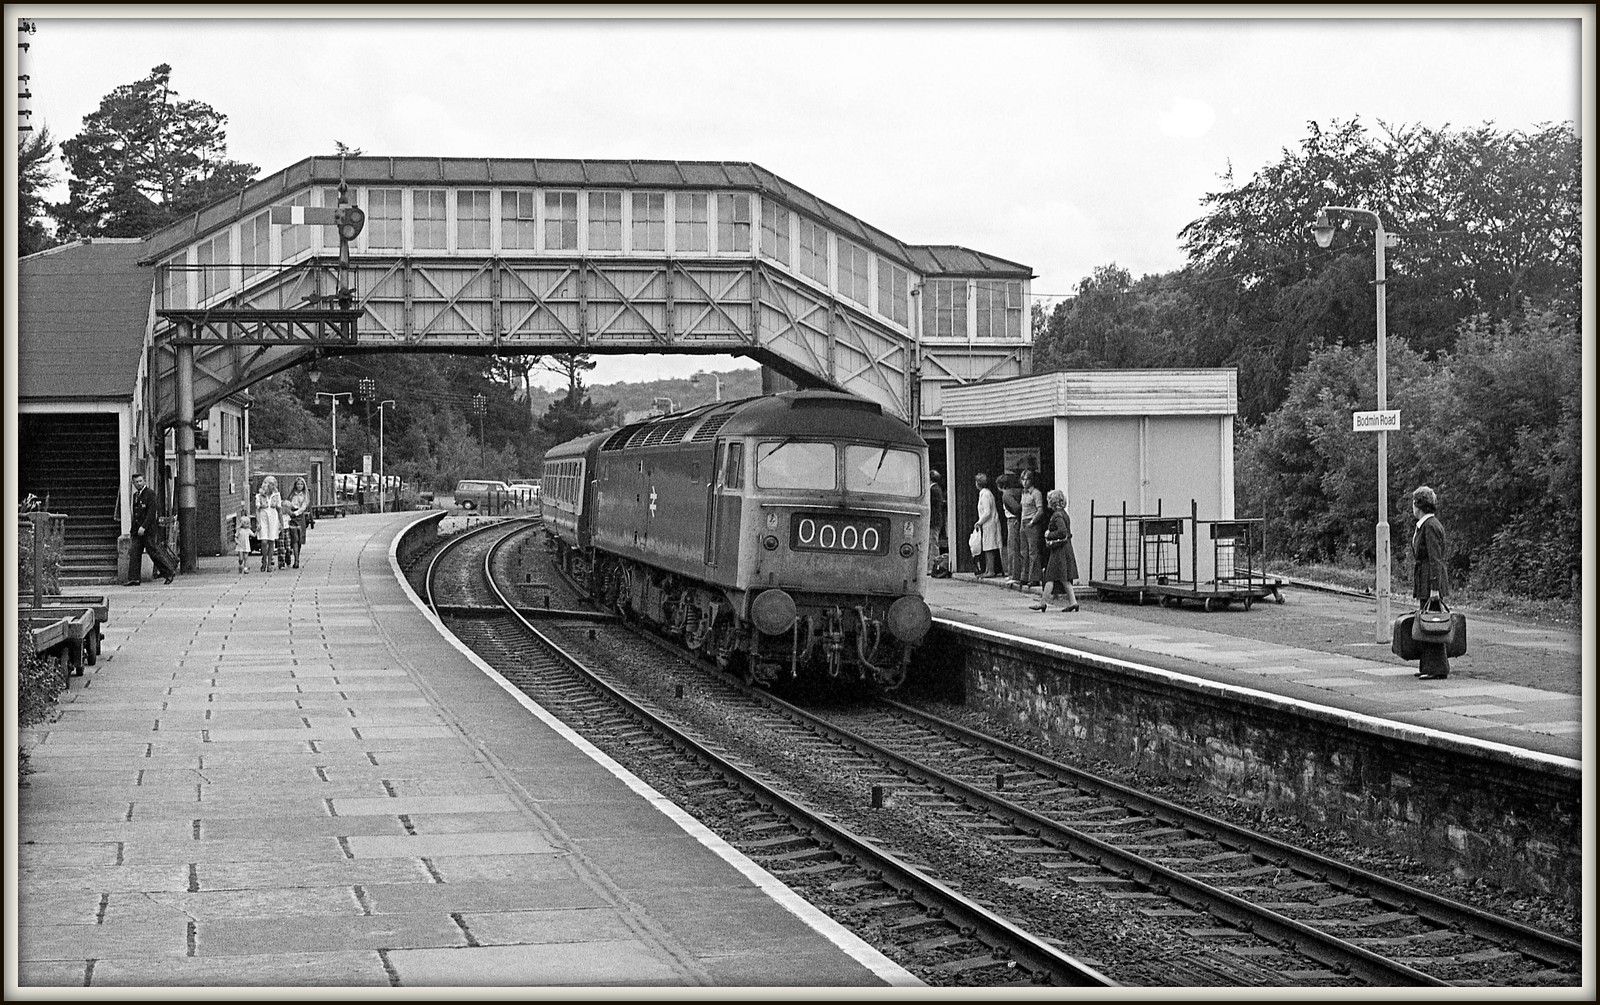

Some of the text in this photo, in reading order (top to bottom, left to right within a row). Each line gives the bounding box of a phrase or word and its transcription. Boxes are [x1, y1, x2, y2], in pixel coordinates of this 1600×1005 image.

[1357, 414, 1396, 426] Bodmin Road
[799, 519, 879, 551] 0000
